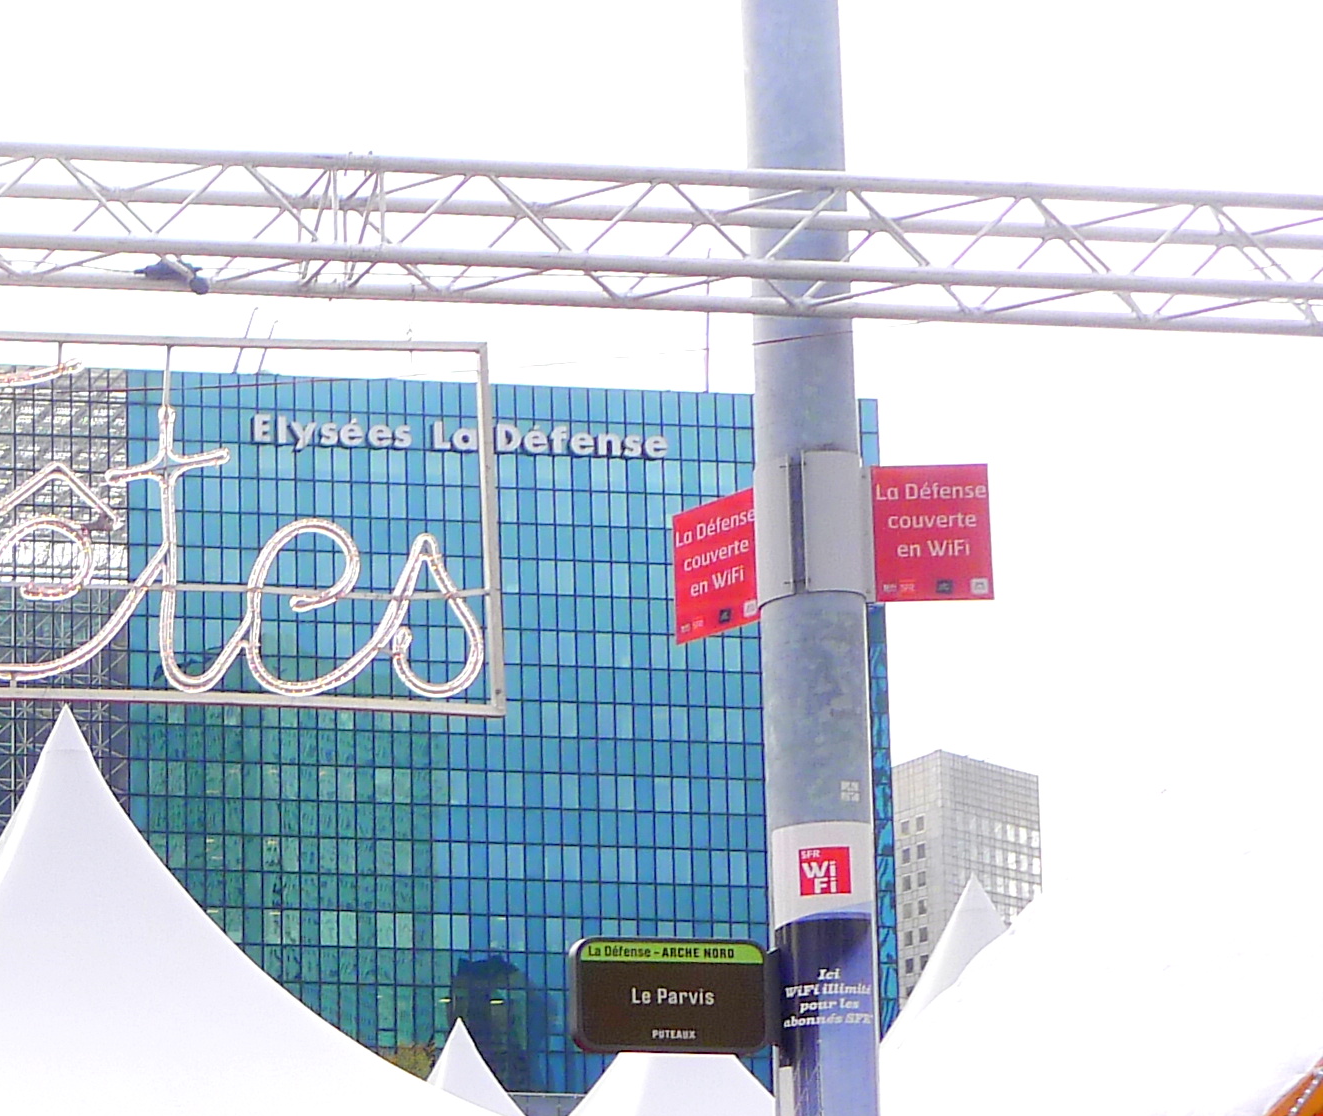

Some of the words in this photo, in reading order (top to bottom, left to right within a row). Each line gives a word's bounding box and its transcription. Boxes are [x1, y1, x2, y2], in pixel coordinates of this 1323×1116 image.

[251, 413, 413, 452] Elysées
[432, 420, 477, 452] La
[494, 423, 670, 460] Défense
[876, 483, 899, 500] La
[905, 481, 987, 500] Défense
[675, 530, 693, 548] La
[696, 508, 756, 540] Défense
[888, 512, 977, 529] couverte
[683, 538, 750, 572] couverte
[896, 543, 921, 558] en
[926, 539, 971, 557] WiFi
[690, 578, 709, 597] en
[711, 564, 745, 591] WiFi
[800, 849, 821, 860] SFR
[588, 945, 601, 957] La
[604, 944, 652, 958] Défense
[662, 947, 700, 958] ARCHE
[704, 948, 735, 960] NORD
[817, 967, 841, 981] Ici
[631, 987, 651, 1005] Le
[657, 987, 715, 1006] Parvis
[785, 983, 820, 999] WiFi
[799, 999, 837, 1014] pour
[840, 998, 860, 1009] les
[783, 1012, 844, 1029] abonnés
[651, 1029, 696, 1040] PUTEAUX
